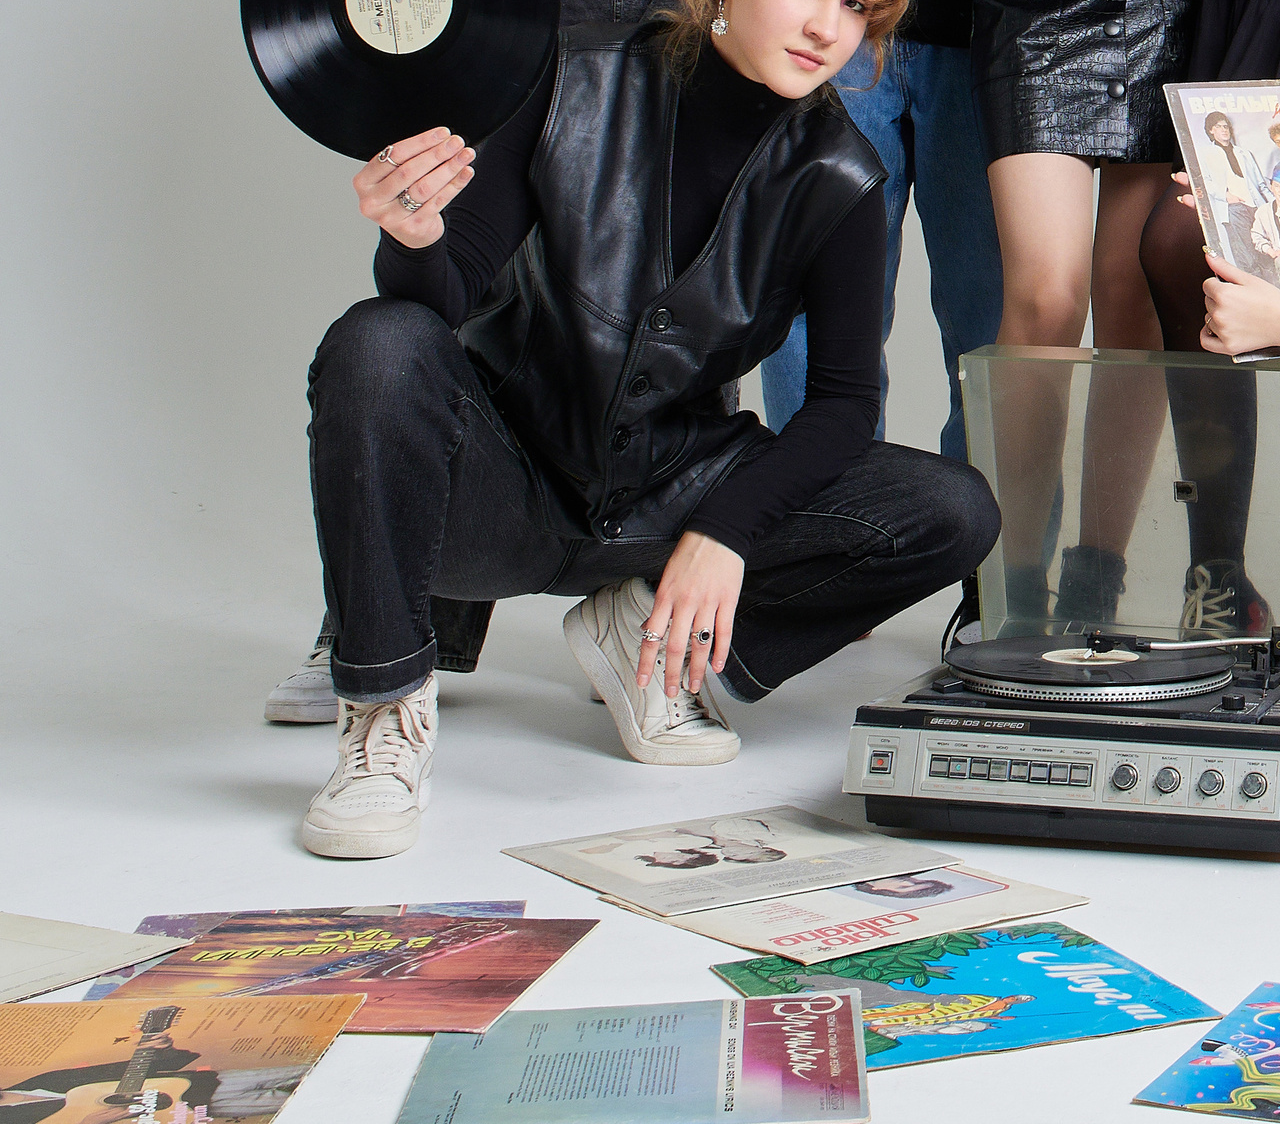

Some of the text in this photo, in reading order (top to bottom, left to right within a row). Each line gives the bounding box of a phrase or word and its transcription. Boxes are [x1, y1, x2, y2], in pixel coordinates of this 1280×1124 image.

[1188, 94, 1278, 114] ВЕСЁЛЫЕ
[314, 928, 392, 942] ЧАС
[190, 938, 402, 962] ВЕЧЕРНИЙ
[1017, 951, 1168, 1021] Маугли
